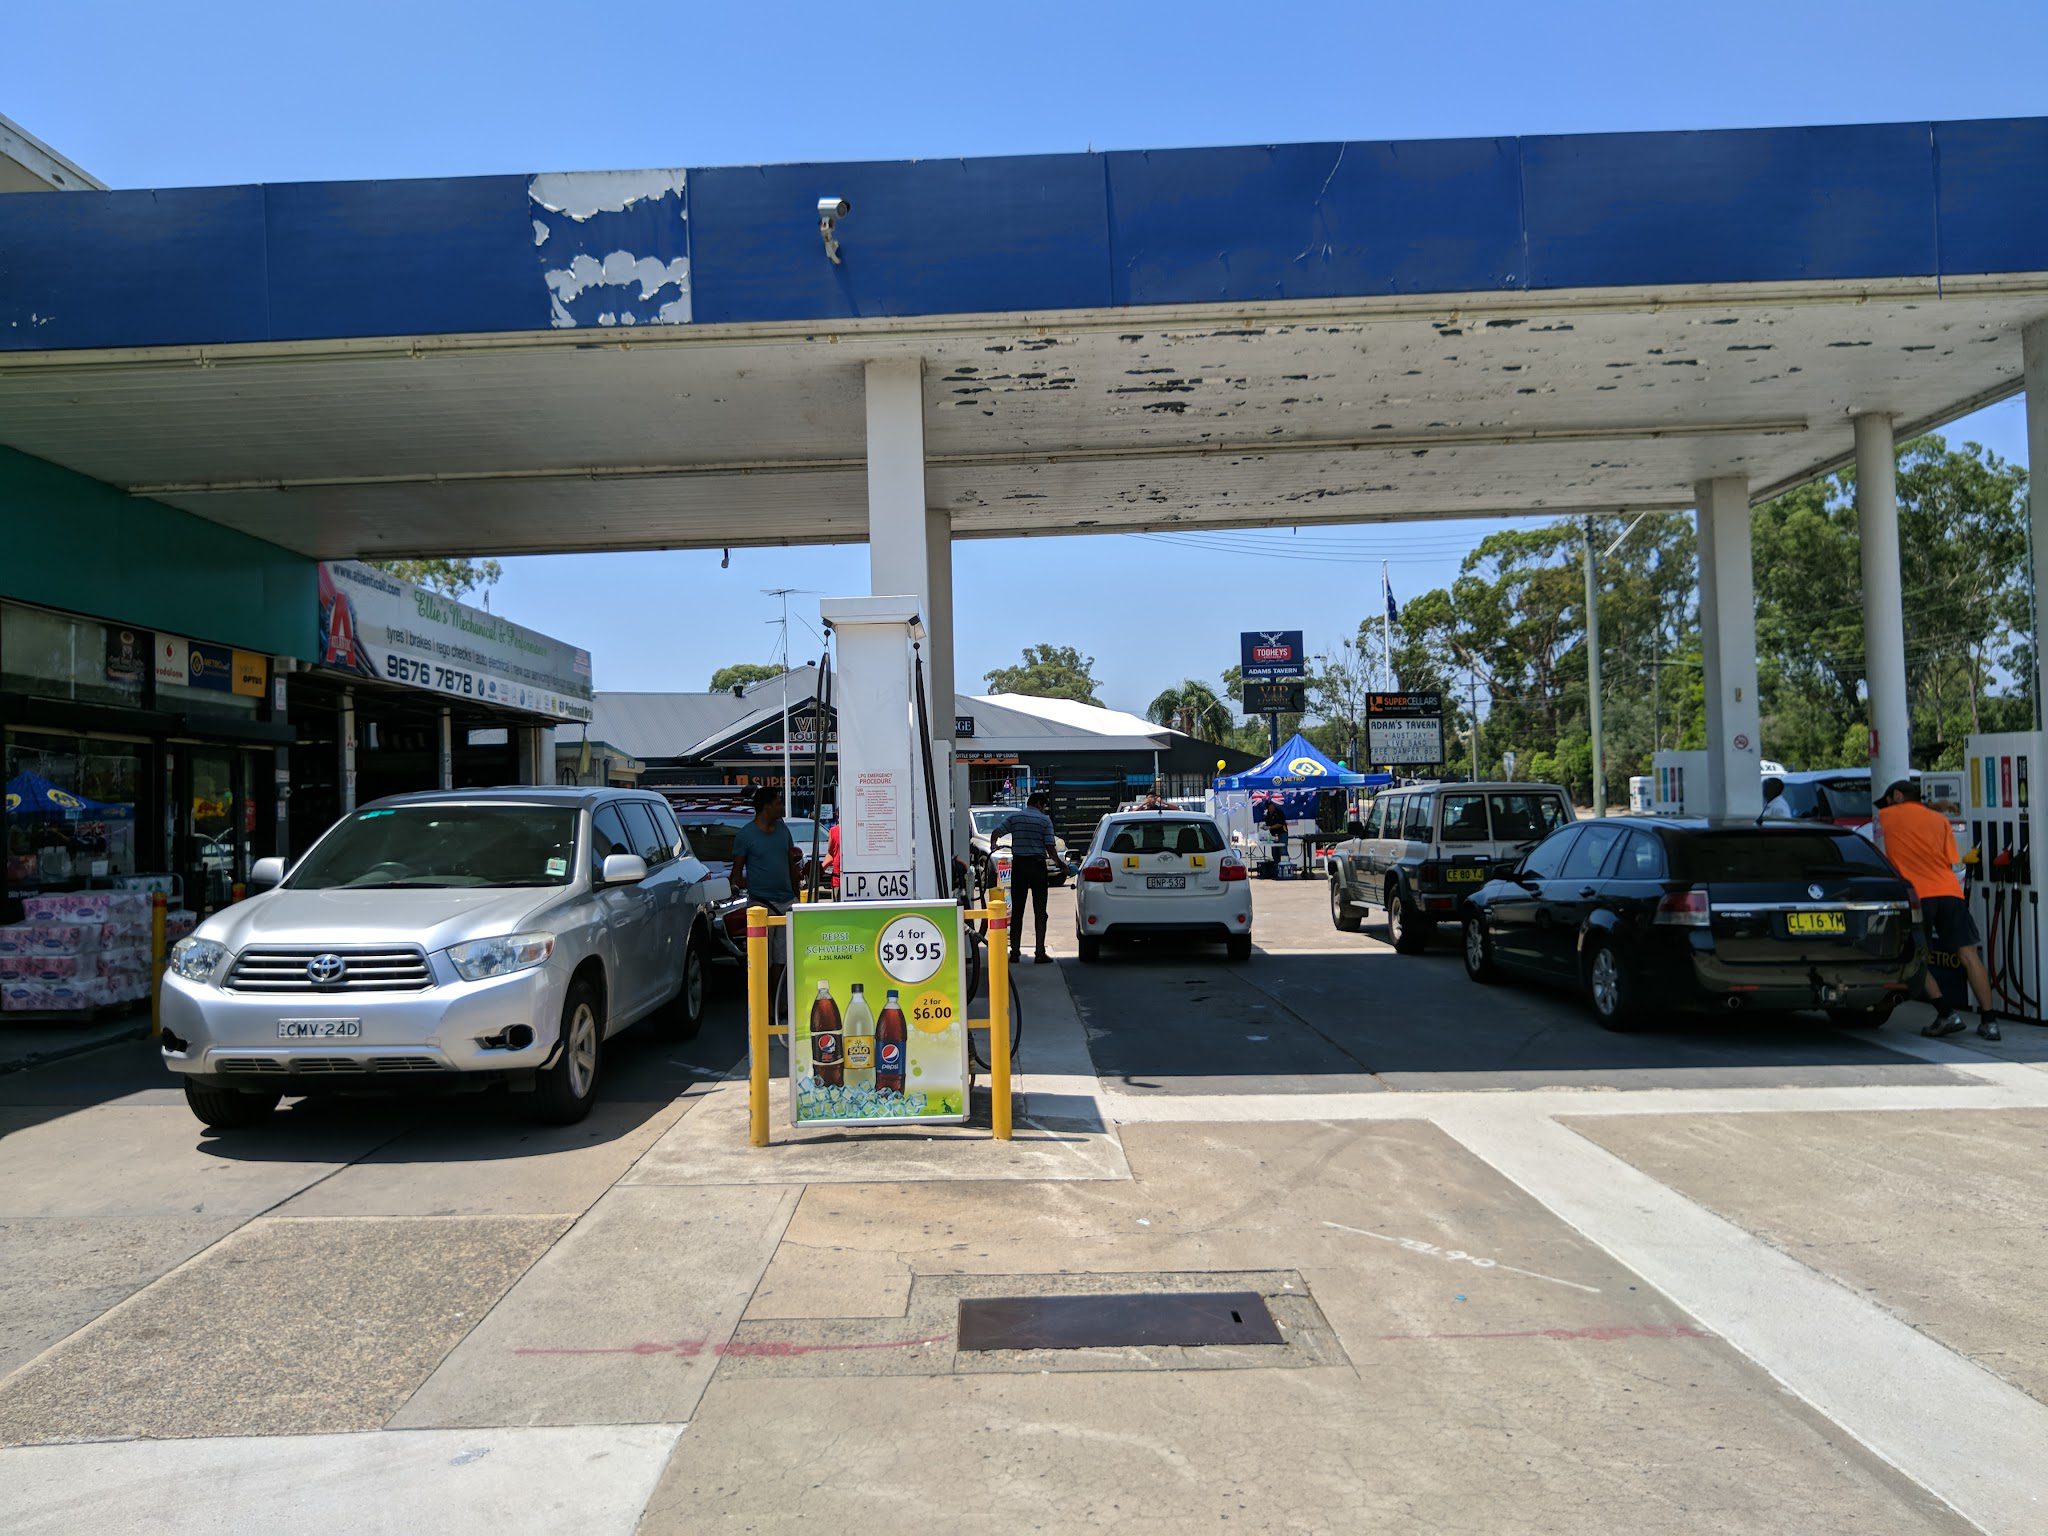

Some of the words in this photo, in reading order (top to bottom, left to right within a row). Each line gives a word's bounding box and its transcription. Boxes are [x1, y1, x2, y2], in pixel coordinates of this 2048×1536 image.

[414, 589, 448, 625] Ellie's
[449, 604, 497, 641] Mechanical
[386, 624, 404, 645] tyres
[409, 632, 432, 653] brakes
[436, 641, 450, 660] rego
[451, 644, 472, 664] checks
[1256, 648, 1288, 656] TOOHEYS
[387, 655, 431, 686] 9676
[435, 666, 473, 694] 7878
[242, 675, 263, 686] OPTUS
[1384, 696, 1438, 706] SUPERCELLARS
[794, 716, 832, 732] VIP
[1371, 719, 1402, 730] ADAM'S
[1407, 720, 1437, 730] TAVERN
[789, 732, 837, 742] LOUE
[1414, 731, 1427, 739] DAY
[1127, 858, 1135, 867] L
[1193, 857, 1202, 866] L
[846, 876, 870, 897] L.P.
[878, 875, 909, 897] GAS
[822, 932, 849, 941] PEPSI
[897, 930, 905, 940] 4
[908, 929, 926, 939] for
[806, 944, 865, 955] SCHWEPPES
[882, 942, 941, 963] $9.95
[1927, 952, 1961, 969] ETRO
[913, 1007, 952, 1020] $6.00
[848, 1046, 870, 1055] SOLO
